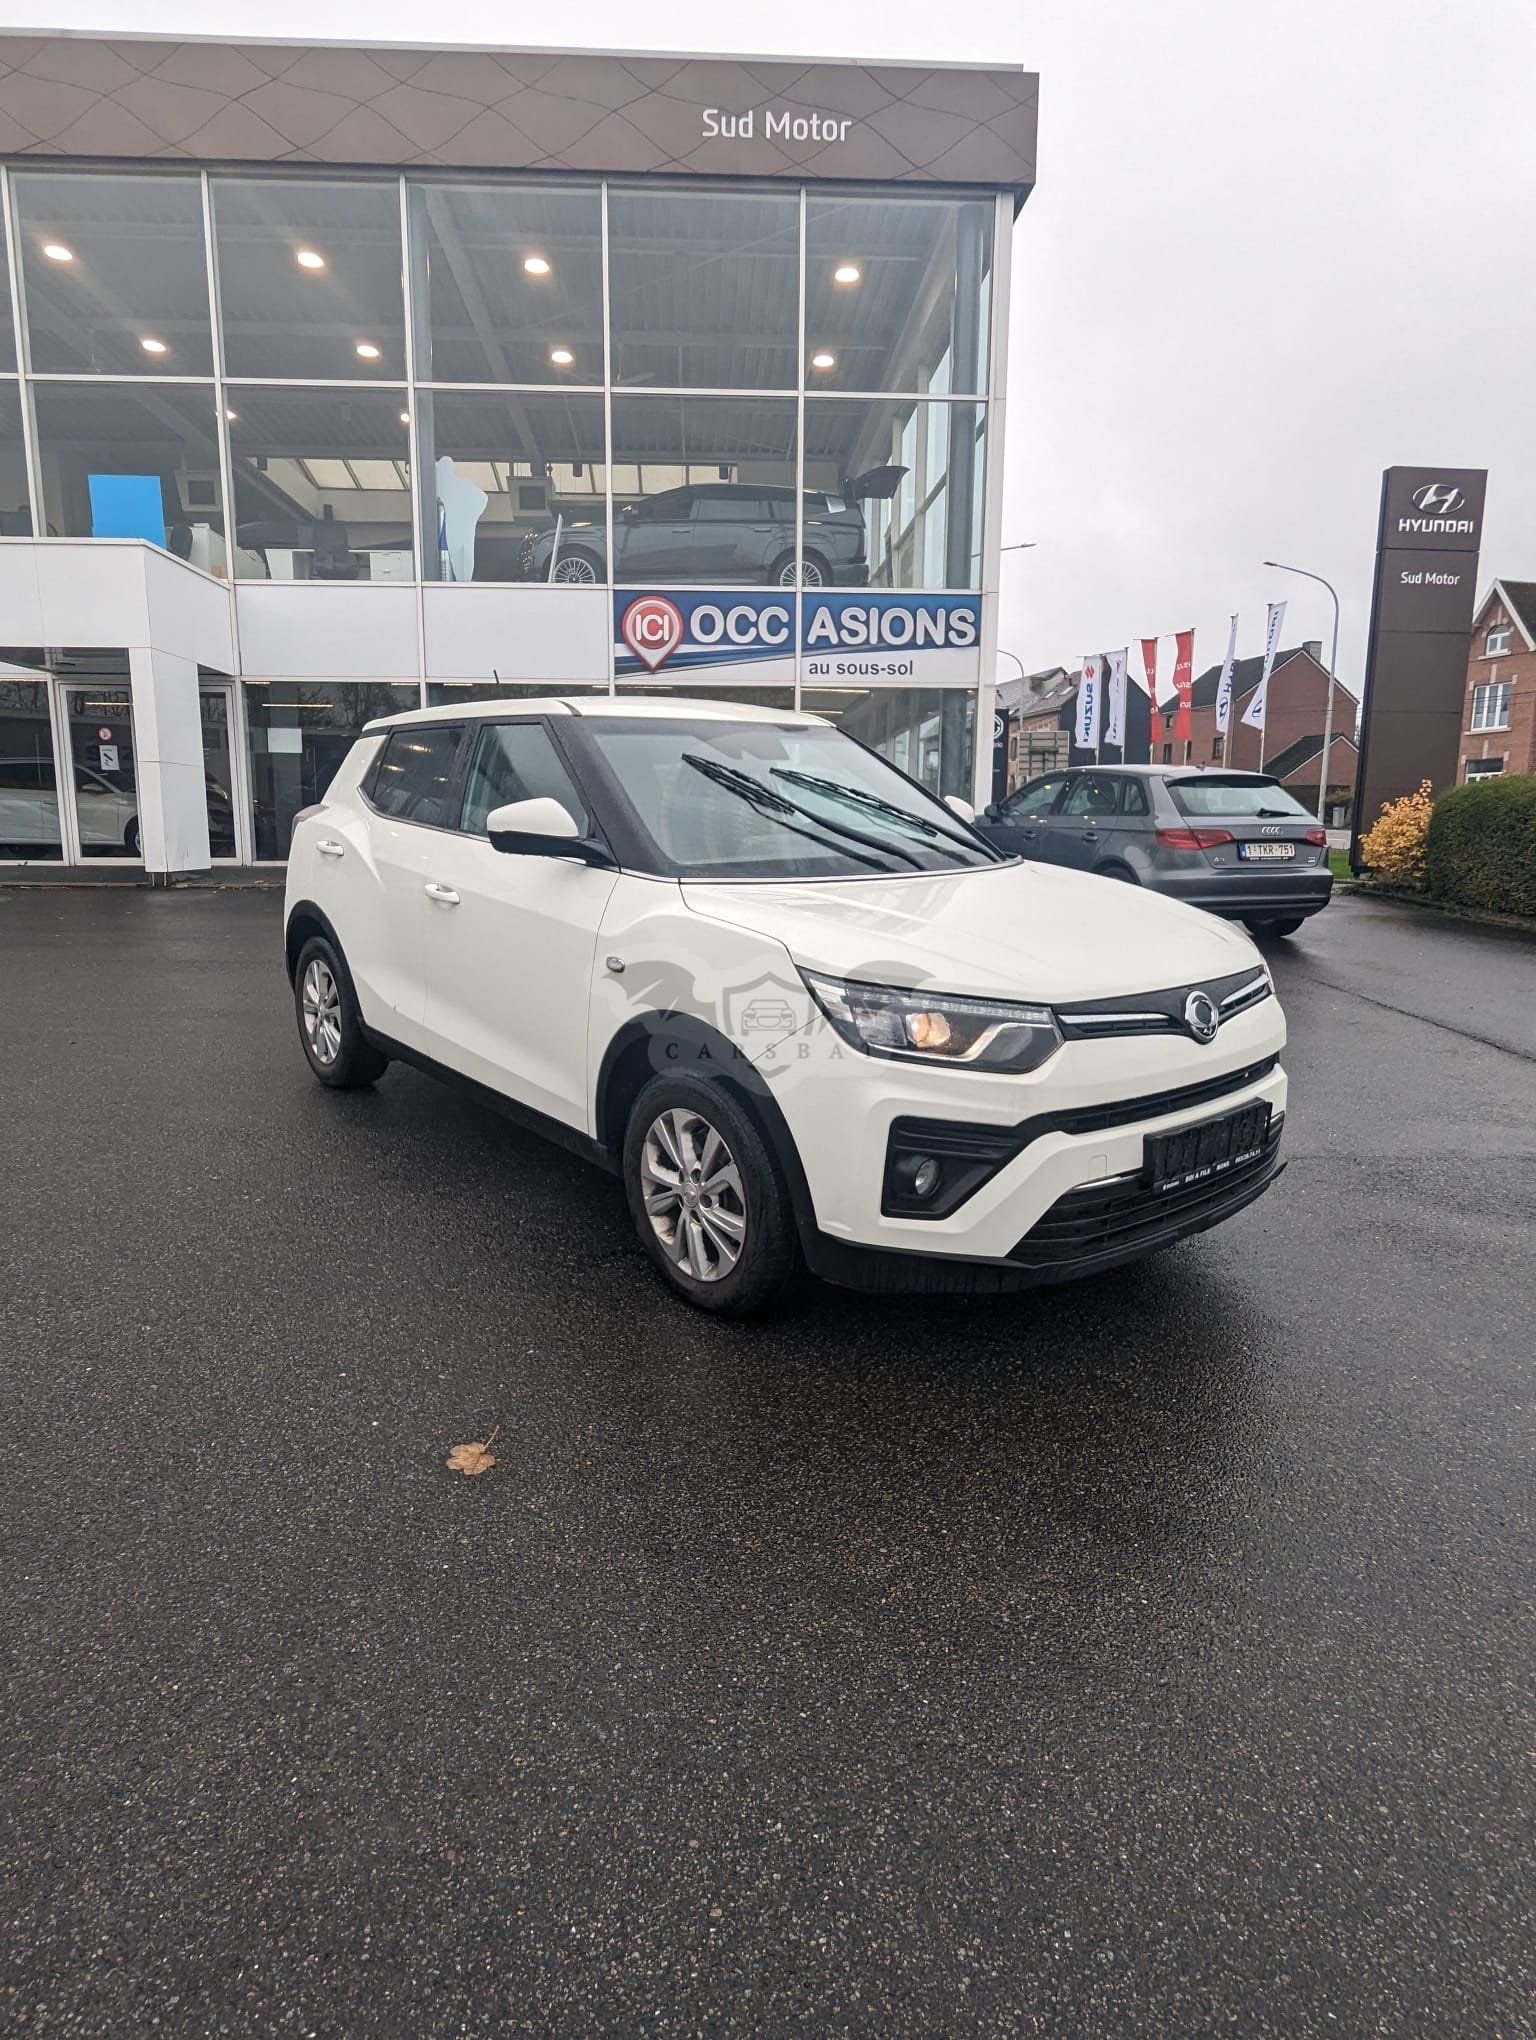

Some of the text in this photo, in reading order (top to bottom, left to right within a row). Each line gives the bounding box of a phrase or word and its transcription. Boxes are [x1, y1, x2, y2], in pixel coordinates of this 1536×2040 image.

[702, 109, 852, 142] Sud Motor
[1398, 518, 1474, 533] HYUNDAI
[1400, 571, 1461, 585] Sud Motor
[635, 614, 670, 641] ICI
[808, 660, 913, 675] au sous-sol
[1083, 682, 1094, 743] SUZUKI
